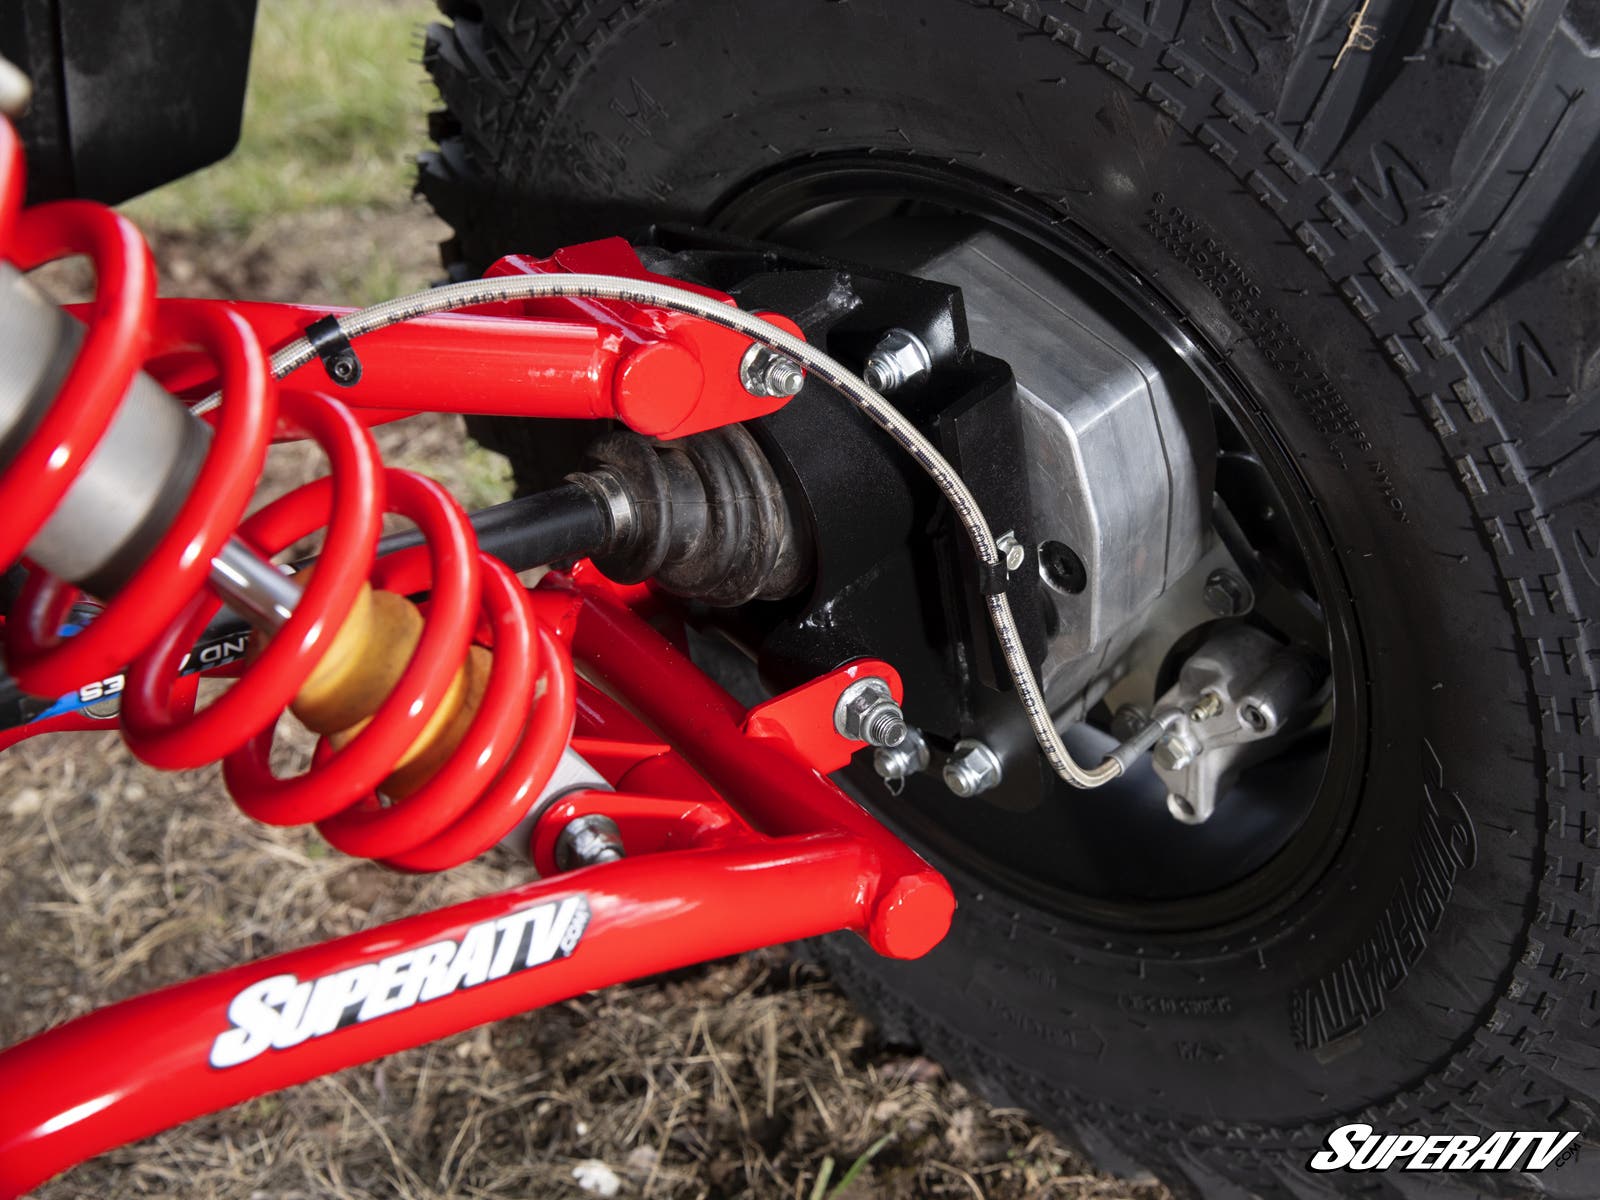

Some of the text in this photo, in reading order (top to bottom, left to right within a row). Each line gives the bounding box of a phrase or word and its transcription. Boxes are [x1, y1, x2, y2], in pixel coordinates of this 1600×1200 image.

[1205, 237, 1263, 299] RATING
[1318, 372, 1372, 451] TUBELESS
[1371, 460, 1411, 524] NYLON
[208, 895, 580, 1069] SUPERATV
